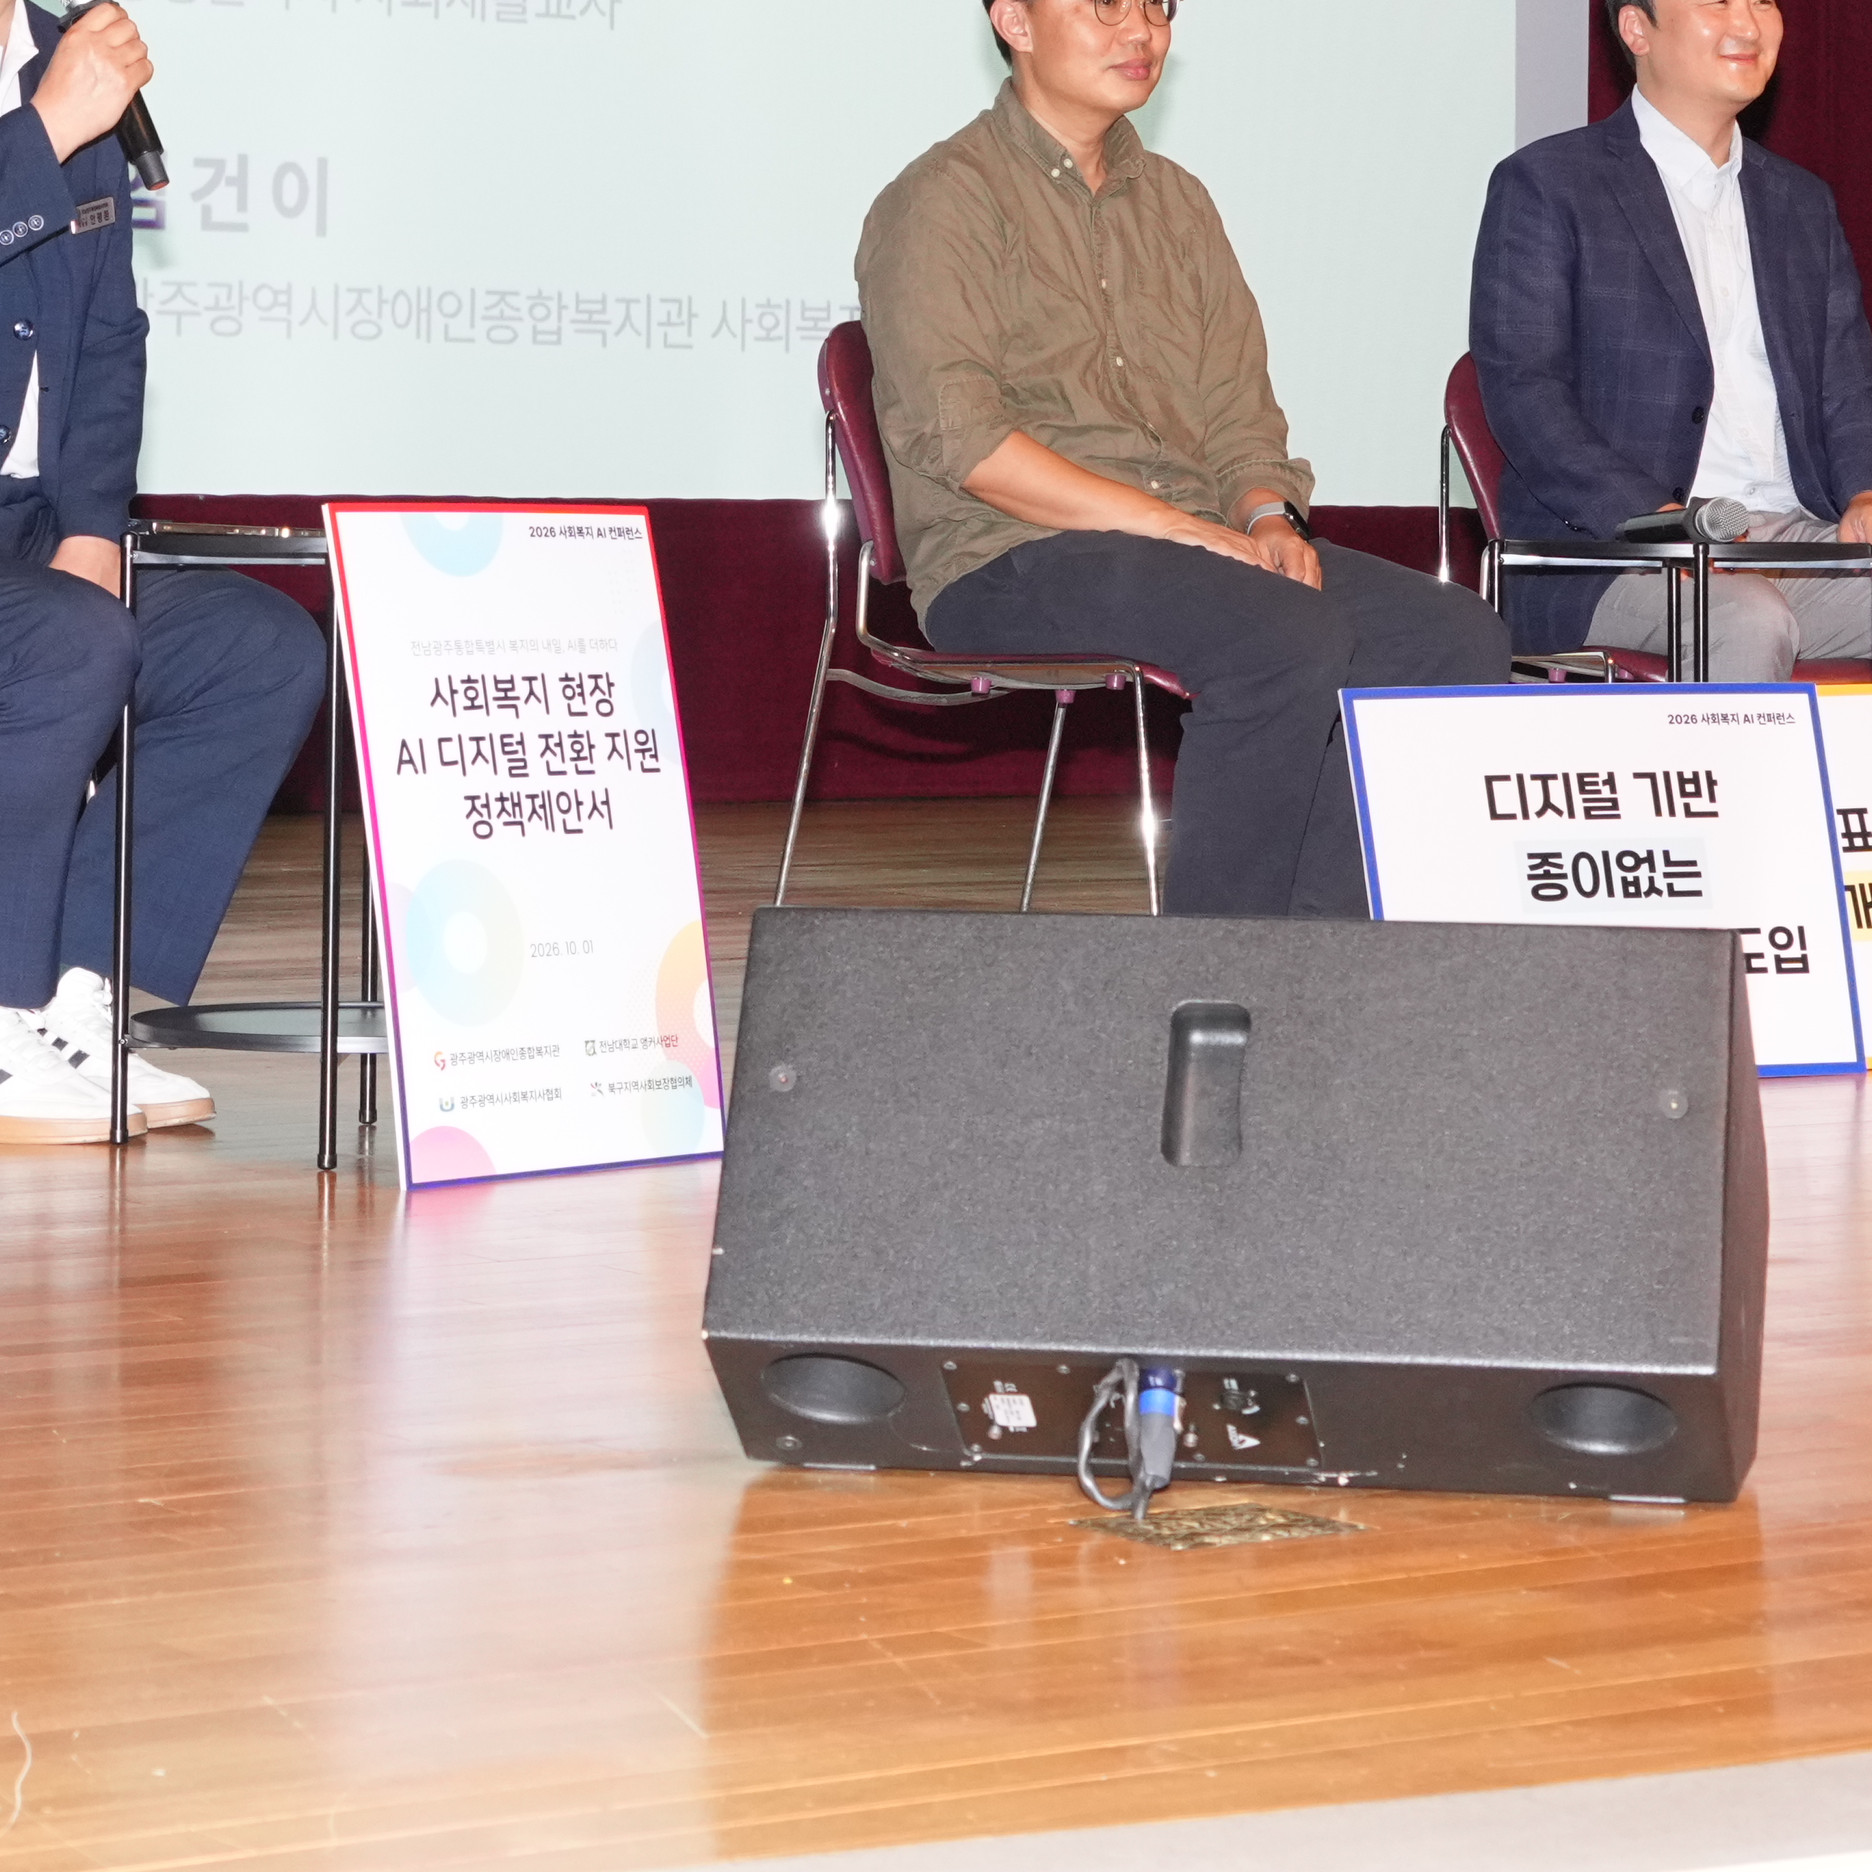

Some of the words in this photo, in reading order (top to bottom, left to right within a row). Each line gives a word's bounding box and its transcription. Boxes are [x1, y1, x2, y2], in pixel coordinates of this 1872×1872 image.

[529, 526, 556, 539] 2026
[559, 525, 594, 540] 사회복지
[597, 528, 607, 539] AI
[608, 526, 643, 541] 컨퍼런스
[410, 639, 506, 657] 전남광주통합특별시
[589, 637, 618, 653] 더하다
[430, 673, 550, 719] 사회복지
[558, 672, 615, 717] 현장
[1668, 714, 1698, 725] 2026
[1701, 712, 1740, 726] 사회복지
[1743, 714, 1754, 725] AI
[1756, 713, 1796, 726] 컨퍼런스
[396, 738, 427, 775] AI
[437, 732, 529, 778] 디지털
[538, 729, 596, 776] 전환
[604, 728, 661, 773] 지원
[1482, 771, 1620, 822] 디지털
[1631, 769, 1719, 819] 기반
[464, 787, 613, 839] 정책제안서
[1526, 848, 1703, 902] 종이없는
[450, 1044, 560, 1066] 광주광역시장애인종합복지관
[599, 1038, 639, 1053] 전남대학교
[460, 1087, 562, 1109] 광주광역시사회복지사협회
